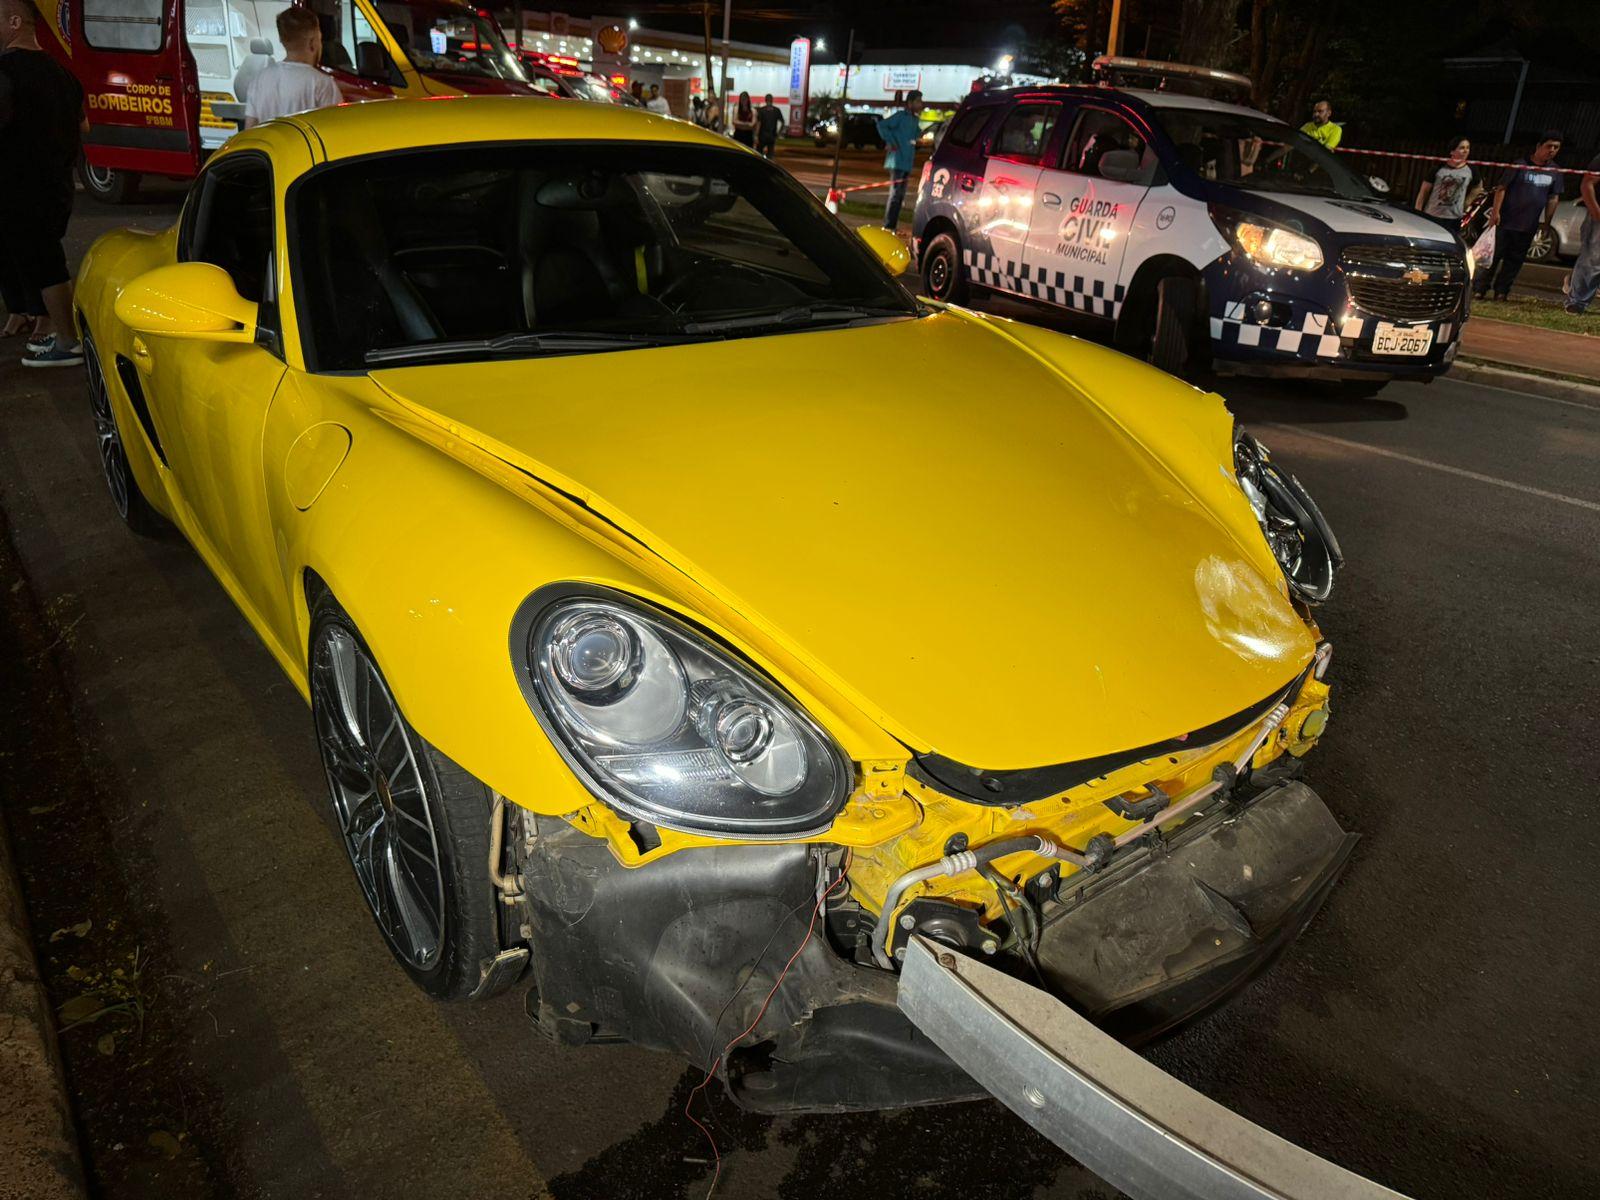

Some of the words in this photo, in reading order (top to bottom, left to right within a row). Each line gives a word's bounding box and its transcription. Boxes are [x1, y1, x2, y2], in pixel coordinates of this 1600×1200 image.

[126, 84, 157, 95] CORPO
[158, 86, 171, 96] DE
[88, 94, 173, 114] BOMBEIROS
[1070, 197, 1118, 219] GUARDA
[1056, 243, 1107, 265] MUNICIPAL
